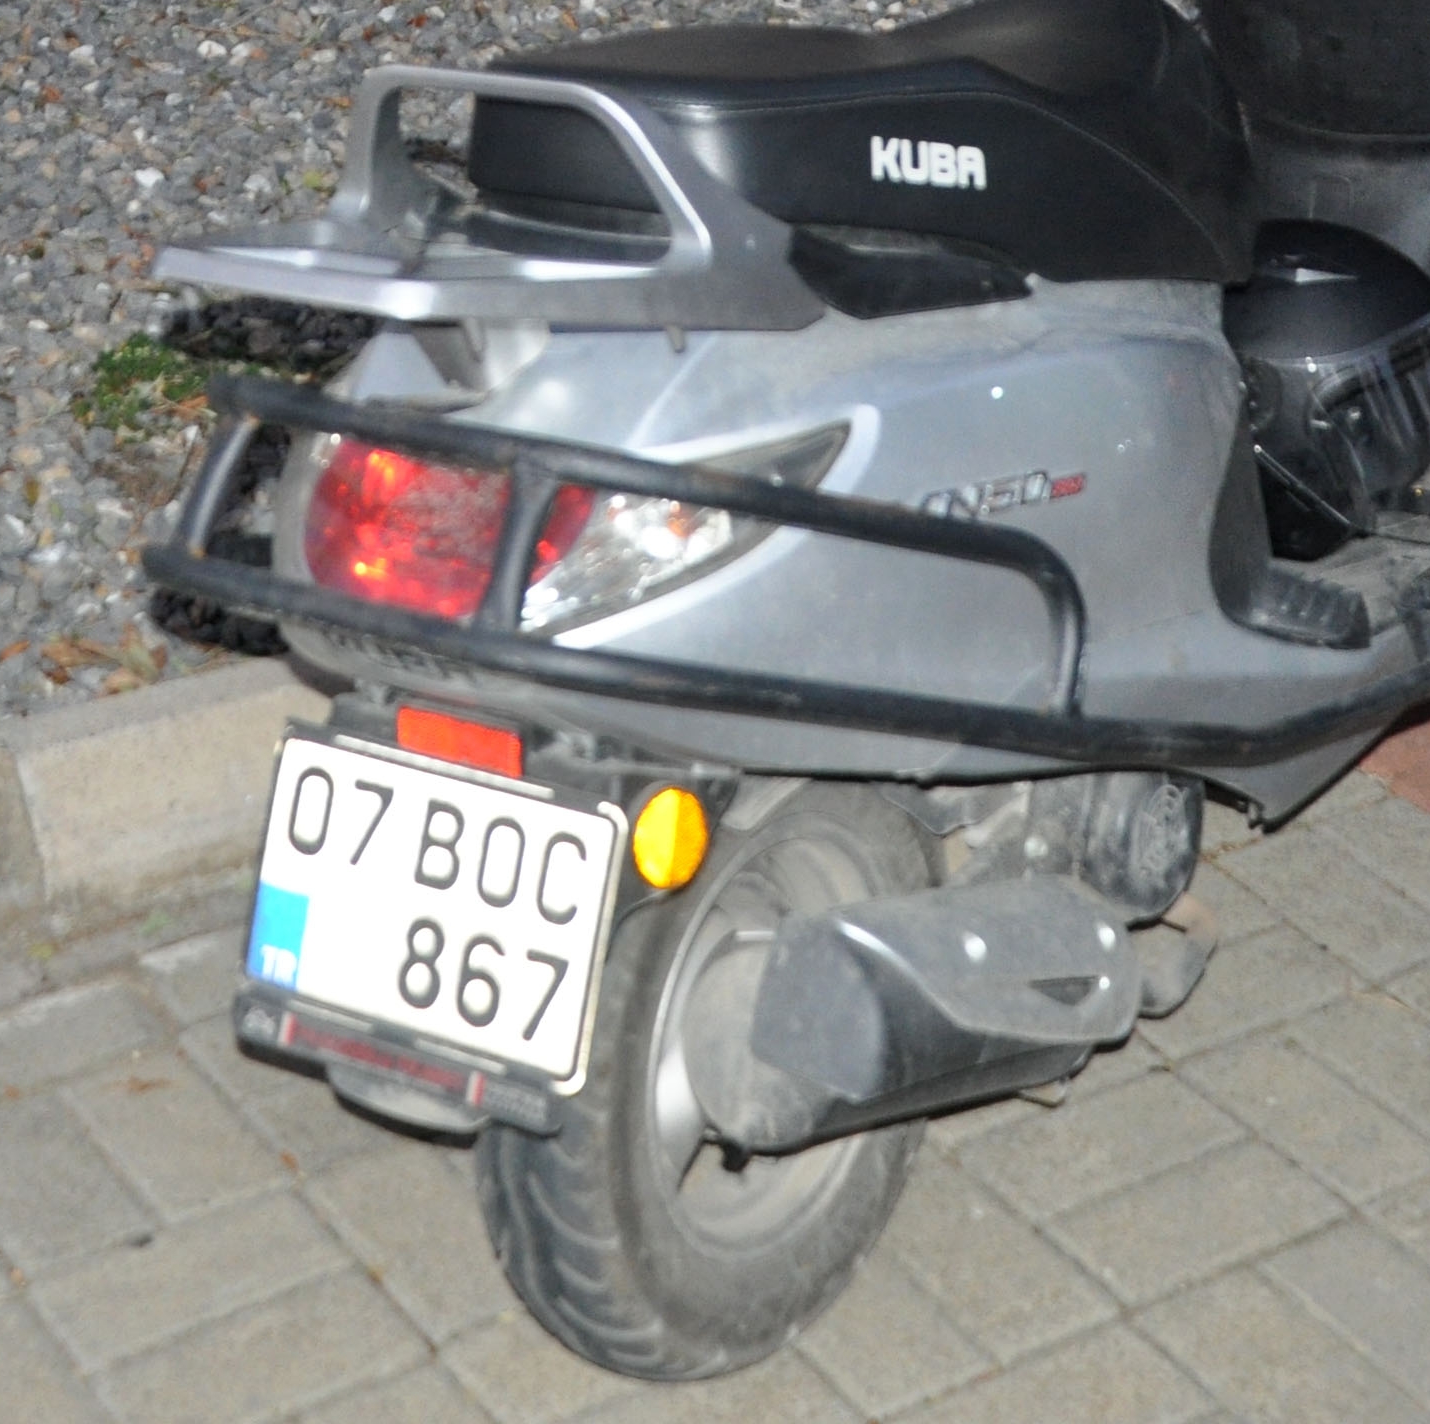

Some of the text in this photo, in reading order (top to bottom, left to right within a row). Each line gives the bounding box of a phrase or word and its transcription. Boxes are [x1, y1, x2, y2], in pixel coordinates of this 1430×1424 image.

[871, 135, 987, 191] KUBA
[288, 766, 587, 925] 07 BOC
[398, 916, 570, 1041] 867
